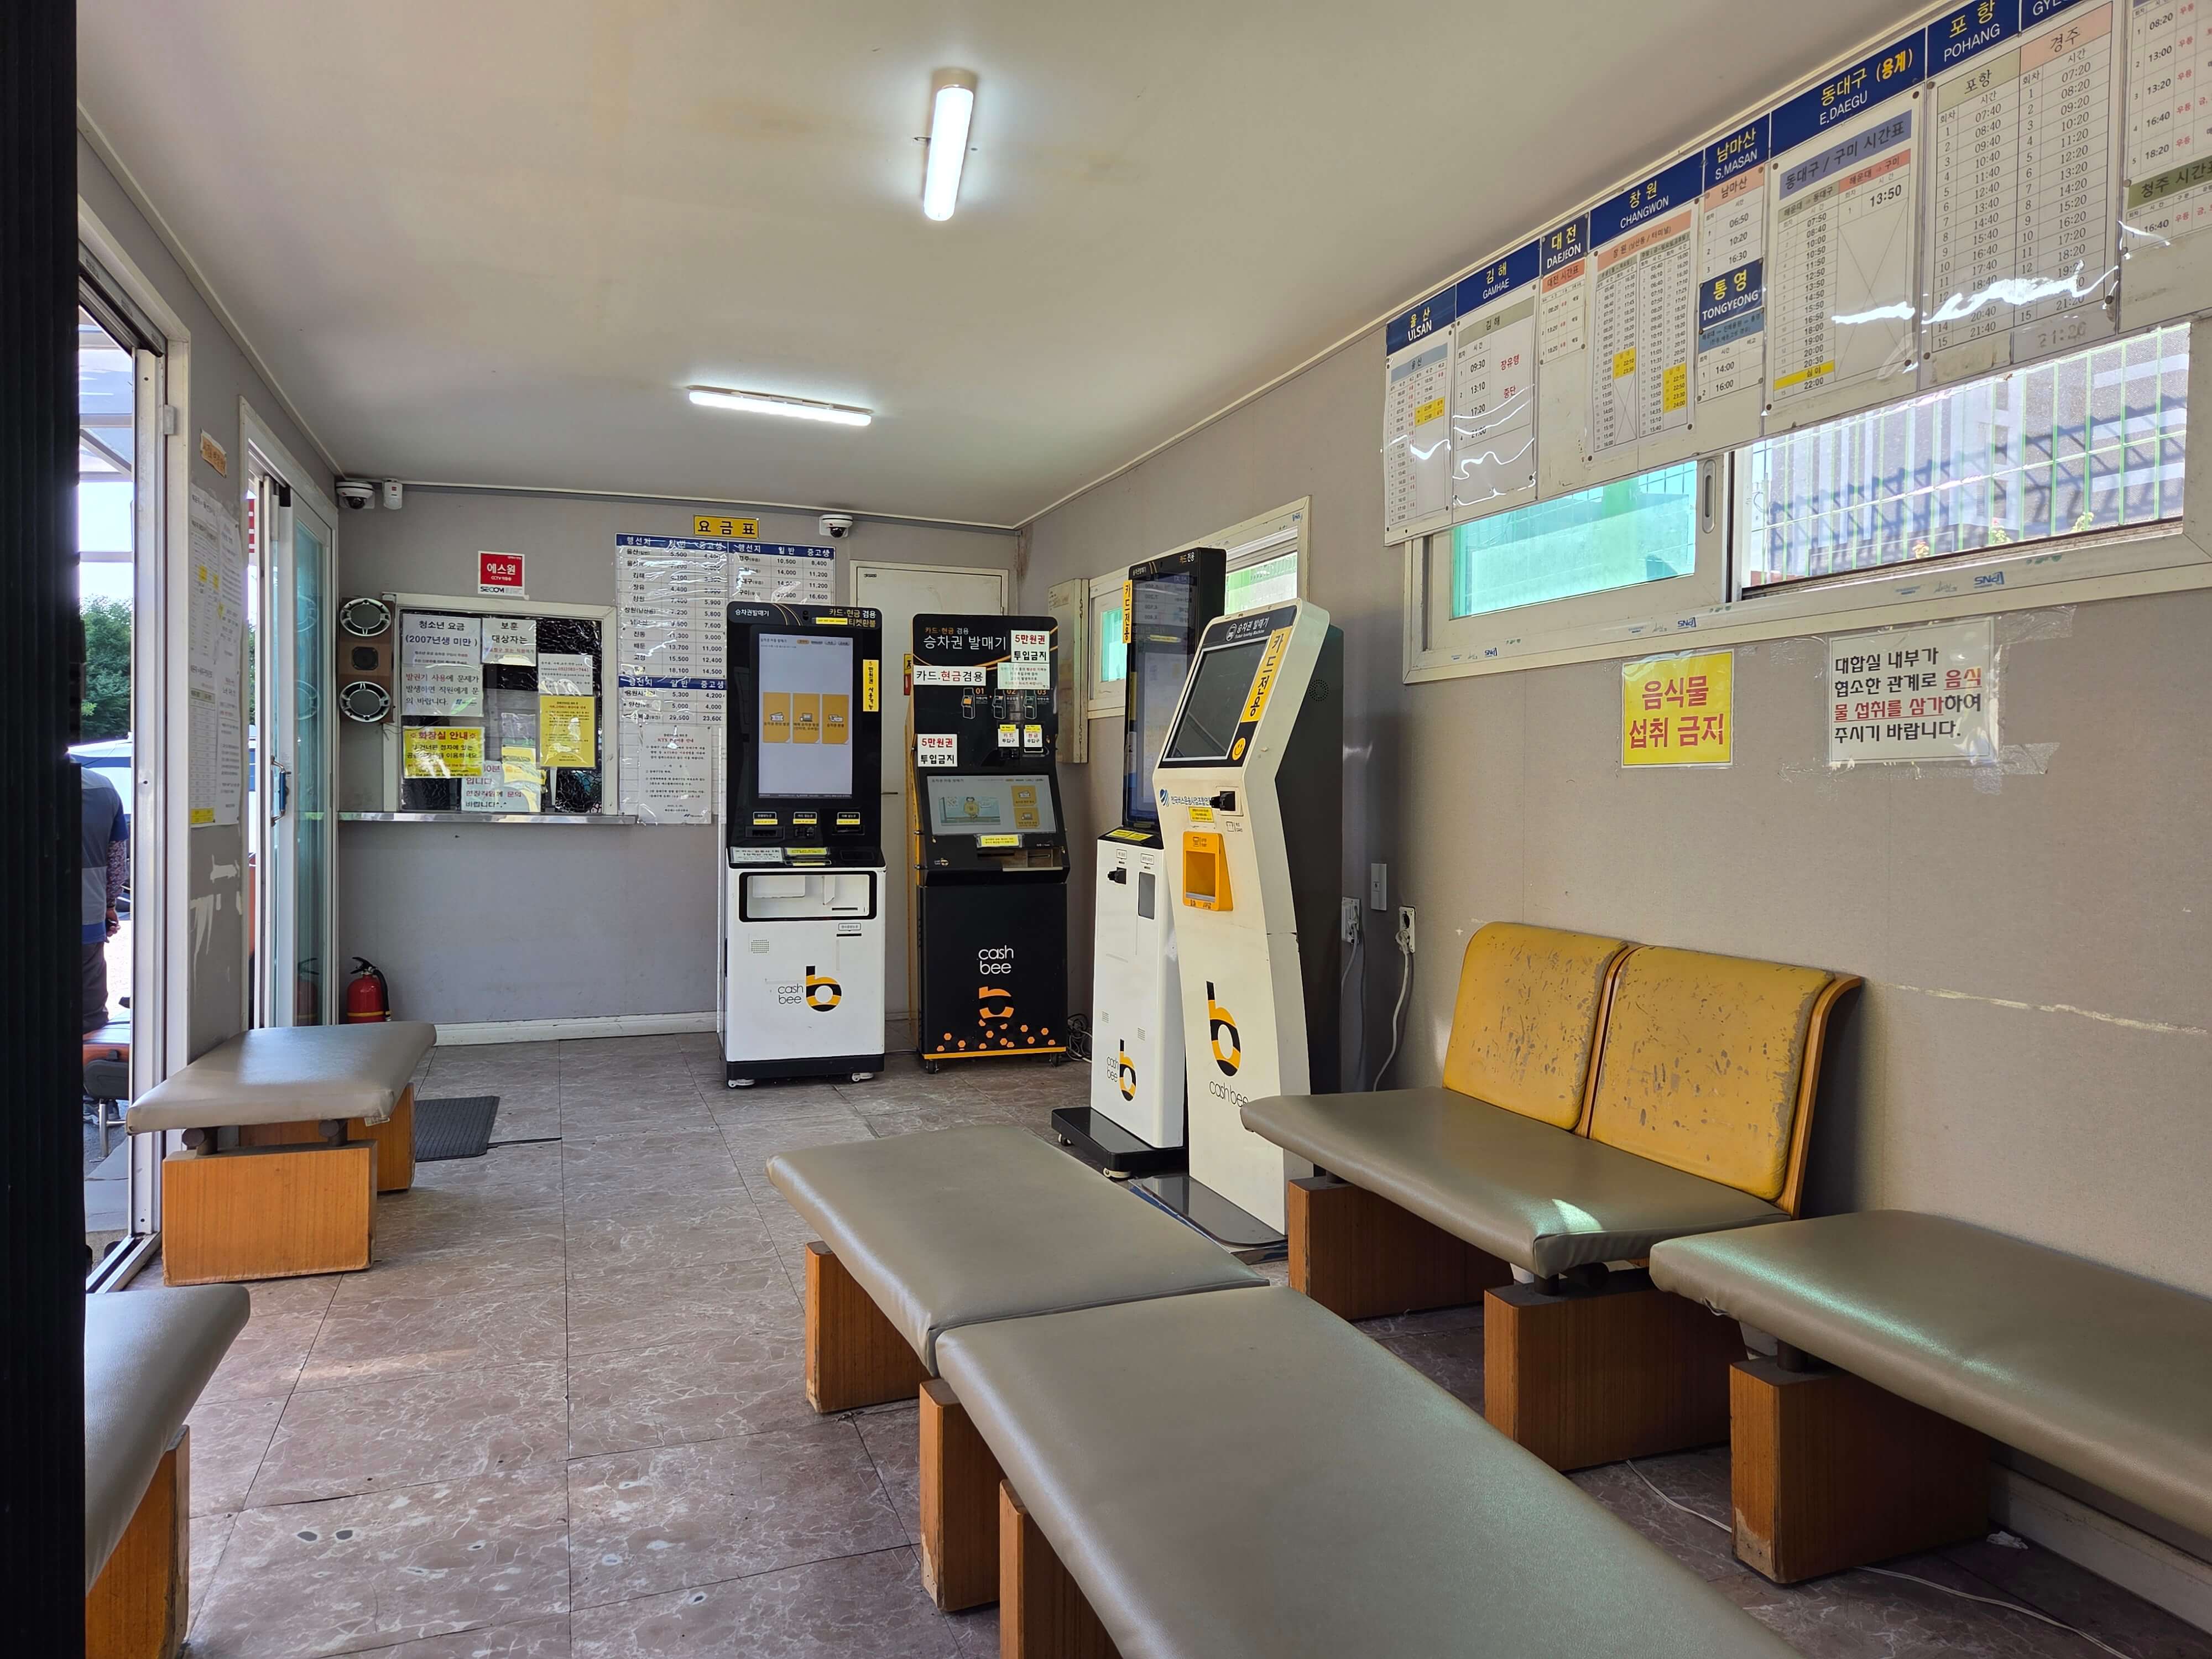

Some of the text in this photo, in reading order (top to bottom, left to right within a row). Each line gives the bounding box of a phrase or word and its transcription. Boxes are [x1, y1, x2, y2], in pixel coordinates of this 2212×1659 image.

[2150, 13, 2173, 30] 08:20
[1944, 23, 2000, 62] POHANG
[2050, 27, 2080, 53] 경주
[1821, 48, 1913, 107] 동대구 (용계)
[2062, 61, 2091, 83] 07:20
[1964, 70, 1992, 95] 포항
[2147, 79, 2171, 95] 13:20
[1981, 90, 1997, 104] 시간
[1820, 91, 1867, 126] E.DAEGU
[1975, 103, 2001, 122] 07:40
[2061, 95, 2089, 116] 09:20
[1940, 110, 1955, 123] 회차
[2146, 111, 2170, 128] 16:40
[1717, 127, 1756, 163] 남마산
[2061, 128, 2088, 148] 11:20
[2176, 136, 2190, 147] 우등
[1785, 121, 1905, 190] 동대구 구미 시간표
[2145, 144, 2169, 160] 18:20
[1715, 149, 1757, 180] S.MASAN
[1885, 156, 1900, 169] 구미
[2060, 161, 2088, 180] 13:20
[1721, 176, 1747, 199] 남마산
[2141, 177, 2169, 198] 청주
[1870, 185, 1902, 207] 13:50
[1620, 195, 1669, 228] CHANGWON
[1974, 197, 1999, 215] 13:40
[1729, 213, 1749, 228] 06:50
[1807, 212, 1827, 227] 07:50
[1729, 232, 1747, 246] 10:20
[1973, 228, 1999, 245] 15:40
[2058, 228, 2086, 246] 17:20
[1547, 243, 1581, 269] DAEJEON
[1729, 250, 1747, 265] 16:30
[2058, 244, 2085, 262] 18:20
[1562, 264, 1579, 280] 시간표
[1806, 268, 1825, 281] 12:50
[1973, 259, 1997, 276] 17:40
[1483, 278, 1510, 299] GAMHAE
[1702, 290, 1759, 321] TONGYEONG
[1408, 320, 1432, 341] ULSAN
[1970, 322, 1996, 338] 21:40
[1470, 359, 1485, 373] 09:30
[1500, 354, 1520, 371] 장유행
[1715, 362, 1734, 374] 14:00
[1471, 382, 1485, 394] 13:10
[1715, 379, 1734, 392] 16:00
[1804, 378, 1824, 389] 22:00
[1504, 385, 1516, 399] 중단
[1471, 404, 1485, 416] 17:20
[738, 544, 761, 553] 행선지
[807, 548, 830, 557] 중고생
[487, 563, 515, 575] 에스원
[862, 610, 877, 619] 겸용
[419, 620, 465, 631] 청소년 요금
[500, 622, 518, 630] 보훈
[849, 619, 876, 628] 티켓환불
[405, 635, 471, 646] (2007년생 미만
[492, 635, 528, 644] 대상자는
[923, 635, 1006, 650] 승차권 발매기
[1015, 634, 1045, 644] 5만원권
[1014, 651, 1047, 661] 투입금지
[1835, 648, 1939, 674] 대합실 내부가
[406, 673, 428, 682] 발권기
[457, 675, 479, 684] 문제가
[1250, 633, 1284, 717] 카드전용
[1835, 667, 1981, 697] 협소한 관계로 음식
[439, 686, 468, 695] 직원에게
[472, 687, 479, 695] 문
[1642, 676, 1709, 711] 음식물
[418, 698, 448, 706] 바랍니다.
[1835, 693, 1981, 721] 물 섭취를 삼가하여
[418, 731, 468, 740] 화장실 안내
[1630, 713, 1723, 749] 섭취 금지
[1835, 721, 1960, 743] 주시기 바랍니다.
[921, 738, 953, 748] 5만원권
[920, 754, 954, 764] 투입금지
[978, 945, 1014, 960] cash
[980, 960, 1011, 975] bee
[778, 983, 804, 994] cash
[779, 995, 801, 1004] bee
[1107, 1056, 1119, 1071] cash
